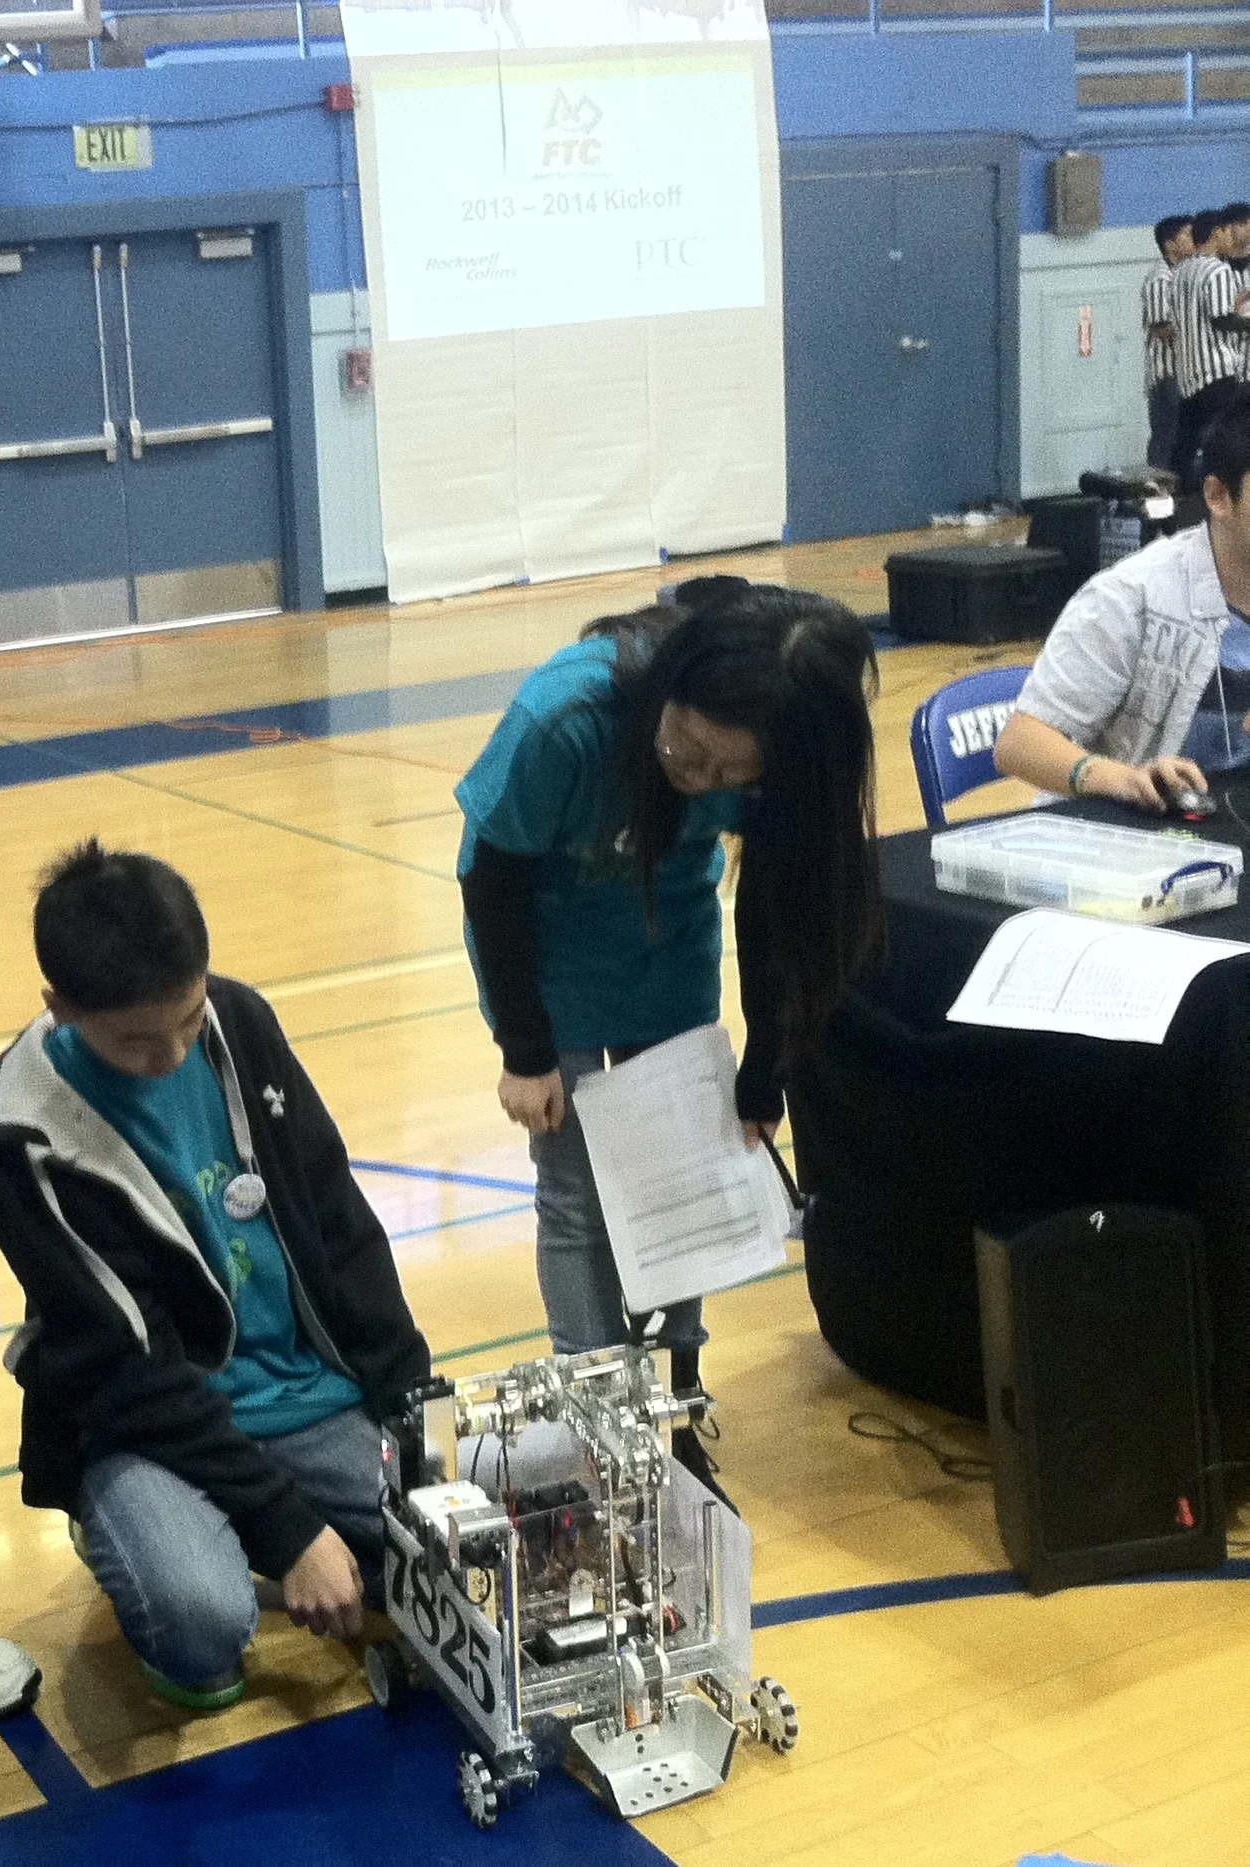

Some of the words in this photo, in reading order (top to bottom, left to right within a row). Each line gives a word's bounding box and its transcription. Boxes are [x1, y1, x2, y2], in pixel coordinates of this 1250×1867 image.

[85, 126, 126, 161] EXIT
[541, 138, 602, 167] FTC
[461, 196, 515, 222] 2013
[543, 190, 598, 217] 2014
[604, 184, 683, 212] Kickoff
[634, 237, 702, 272] PTC
[946, 702, 1016, 759] JEFF
